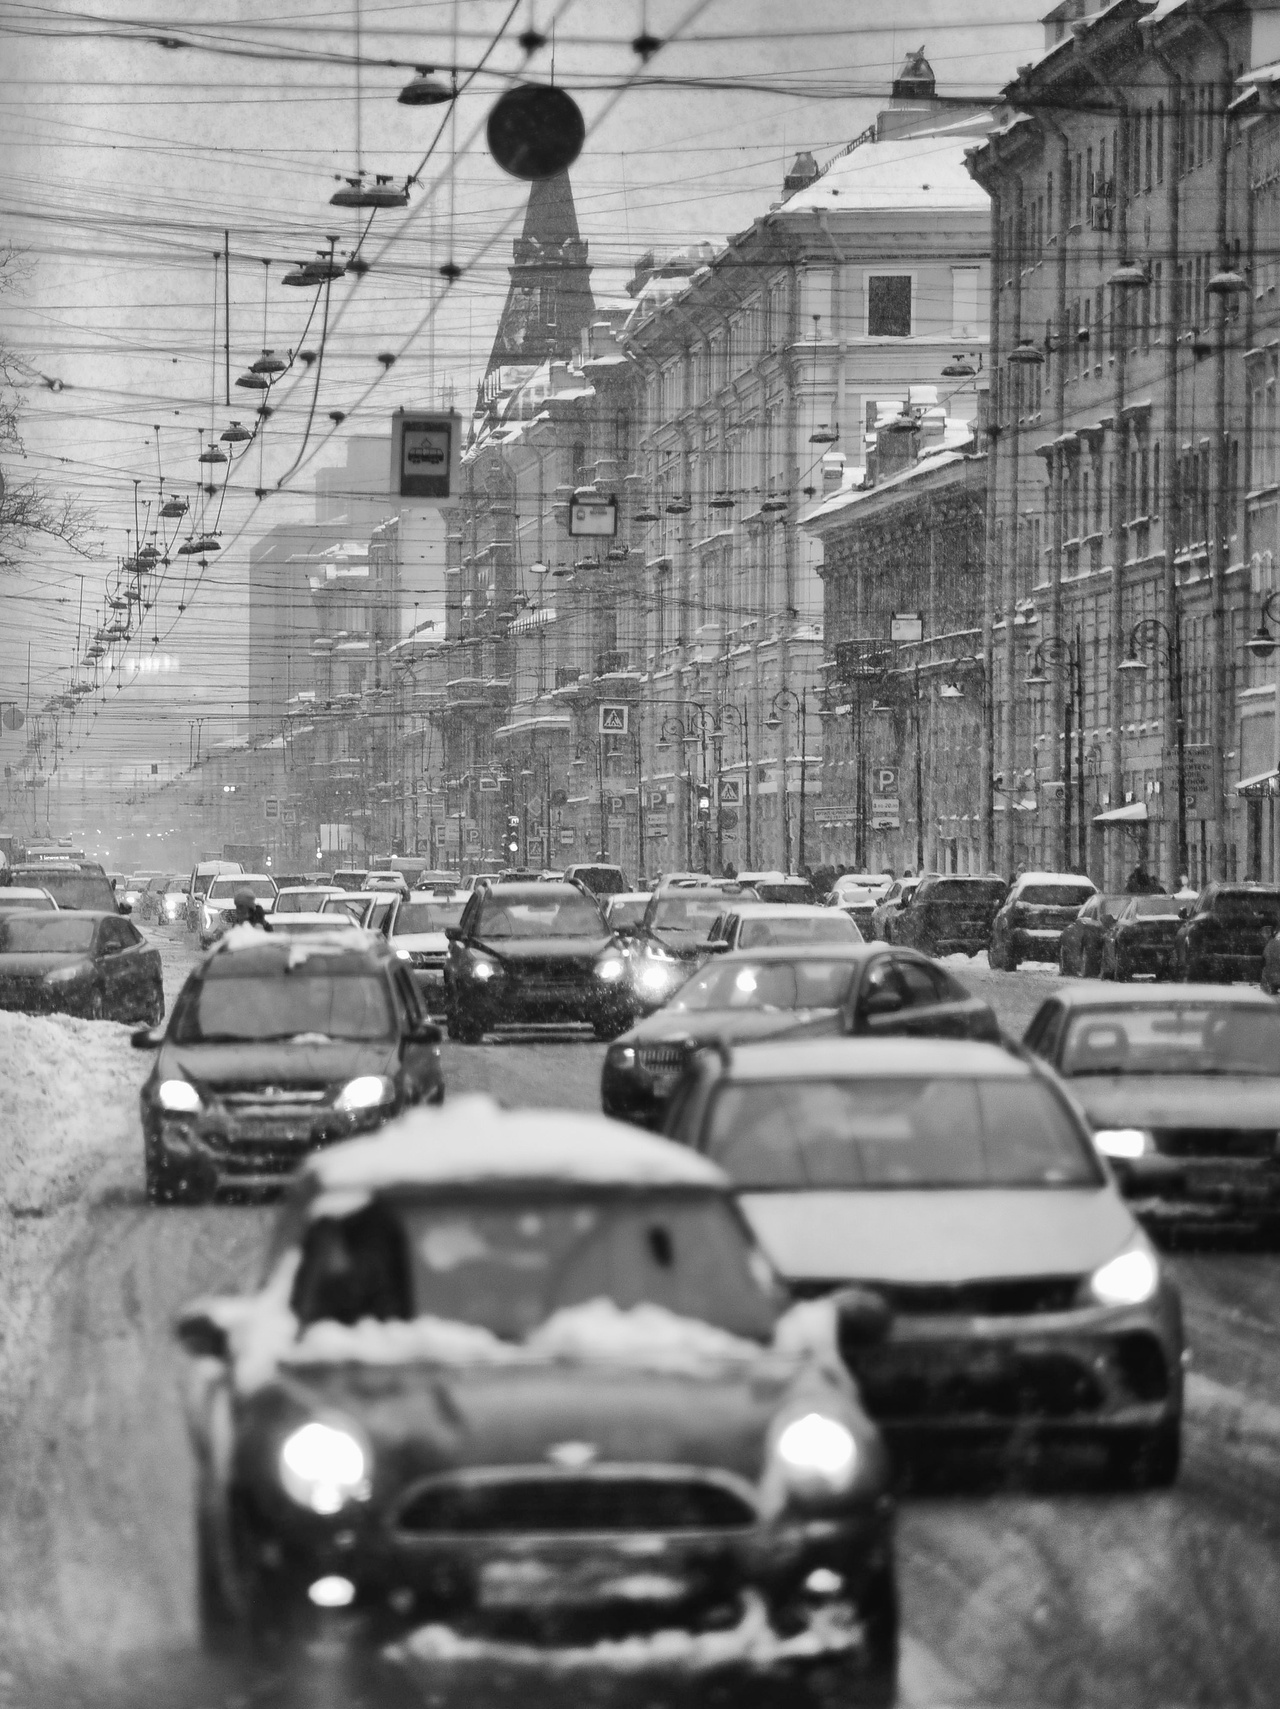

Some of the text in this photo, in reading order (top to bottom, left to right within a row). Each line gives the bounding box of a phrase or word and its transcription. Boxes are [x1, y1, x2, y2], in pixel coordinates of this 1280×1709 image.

[880, 771, 894, 791] P
[612, 798, 623, 813] P
[650, 792, 663, 809] P
[1185, 796, 1194, 808] P
